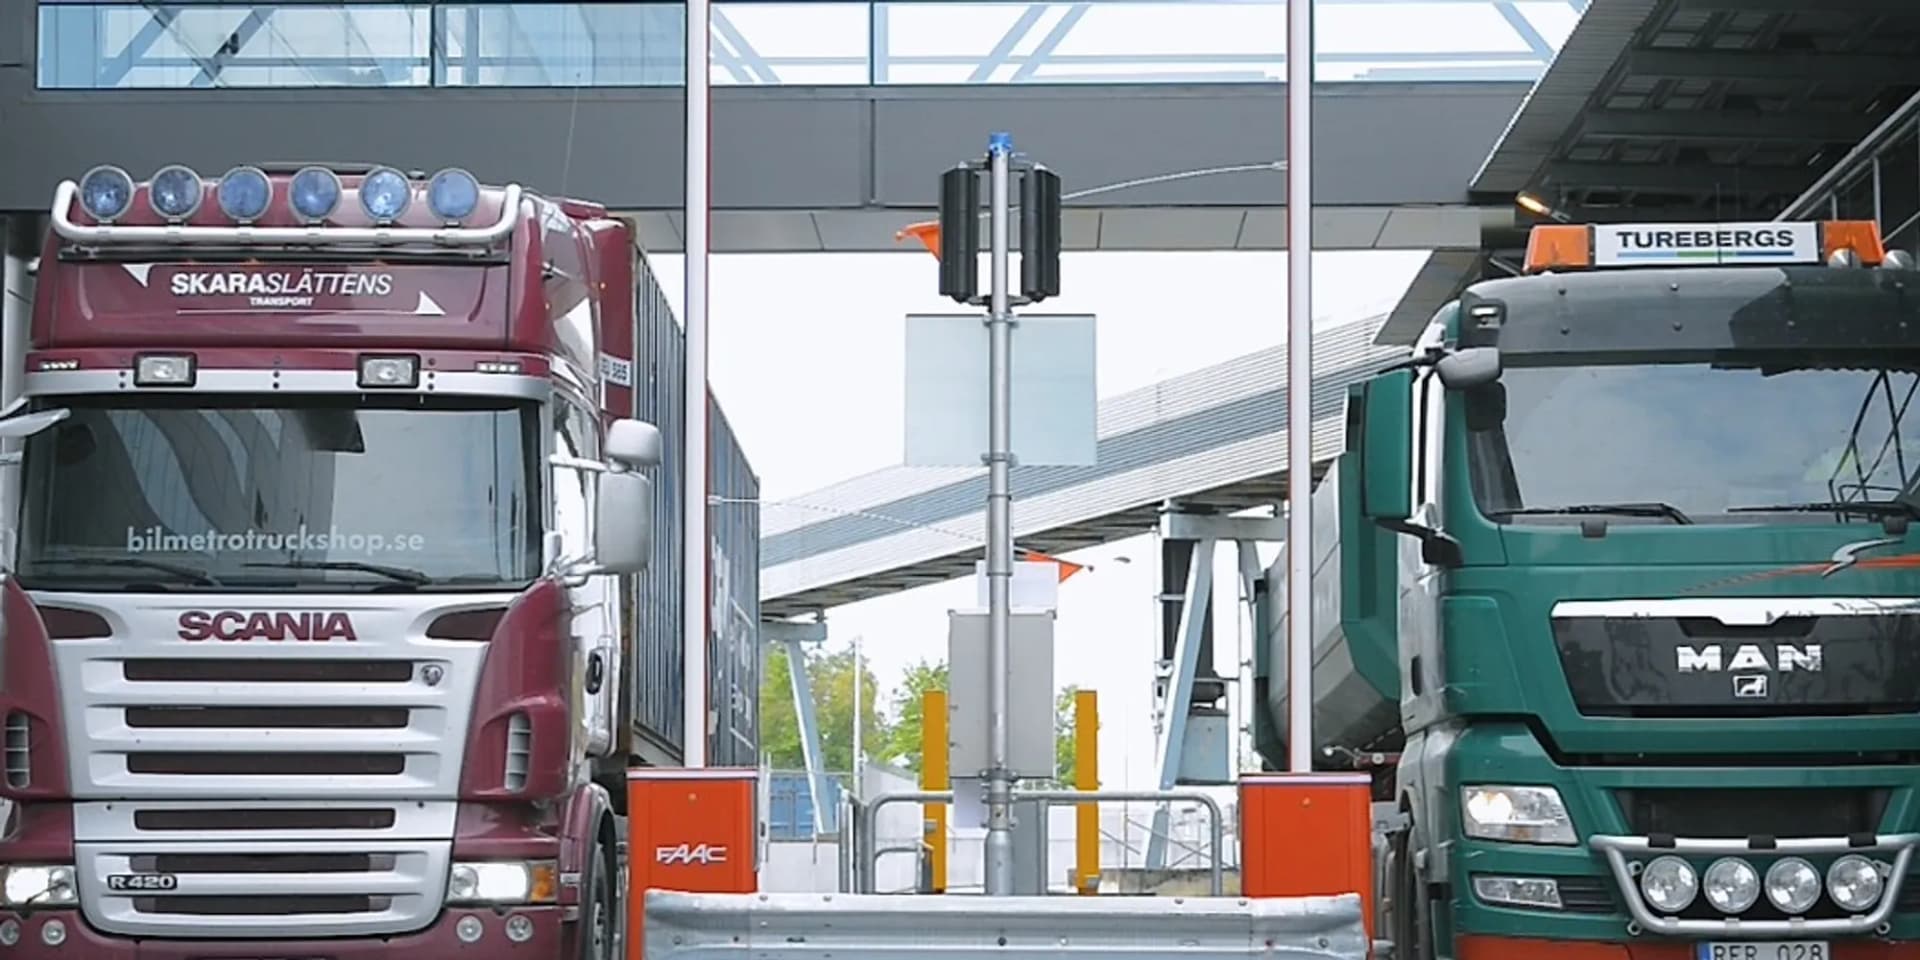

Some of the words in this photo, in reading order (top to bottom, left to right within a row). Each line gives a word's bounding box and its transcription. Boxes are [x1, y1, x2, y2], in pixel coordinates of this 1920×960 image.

[1616, 230, 1795, 248] TUREBERGS
[171, 268, 392, 294] SKARASLÄTTENS
[249, 297, 314, 306] TRANSPORT
[127, 526, 424, 554] bilmetrotruckshop.se
[178, 611, 357, 641] SCANIA
[1676, 645, 1821, 672] MAN
[656, 843, 728, 864] FAAC
